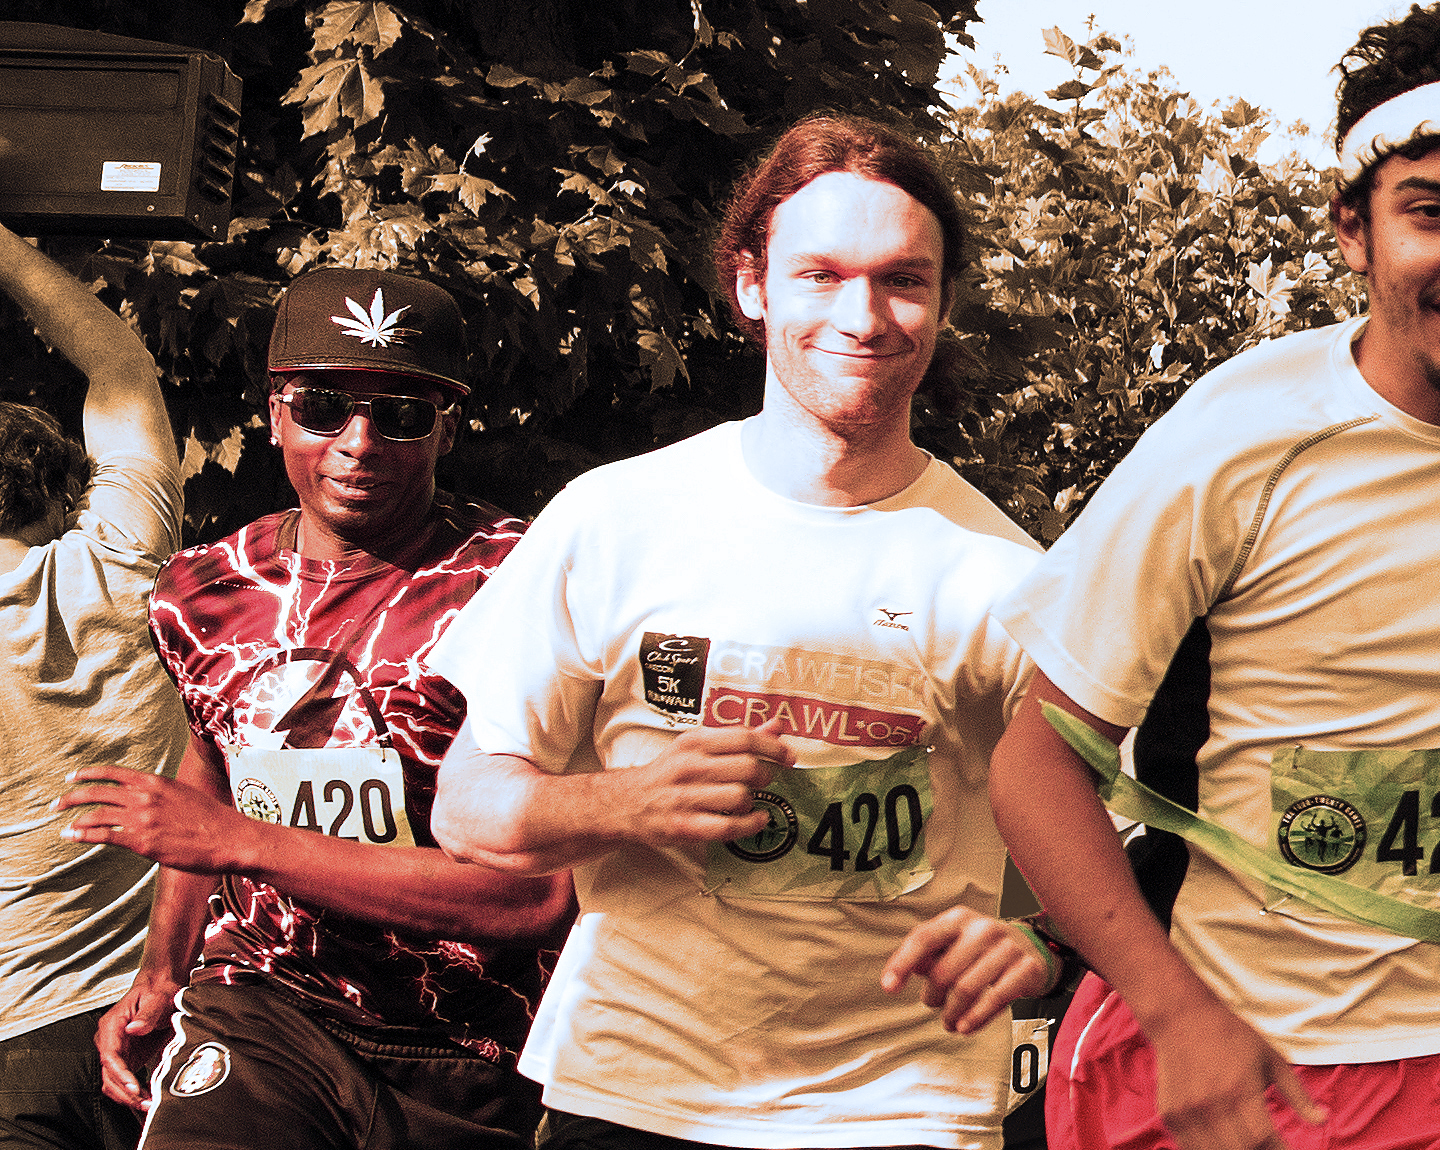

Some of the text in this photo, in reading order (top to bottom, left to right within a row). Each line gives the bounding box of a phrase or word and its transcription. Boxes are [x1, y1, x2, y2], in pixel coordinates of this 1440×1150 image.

[657, 675, 680, 694] 5K
[290, 778, 398, 844] 420
[807, 783, 923, 872] 420
